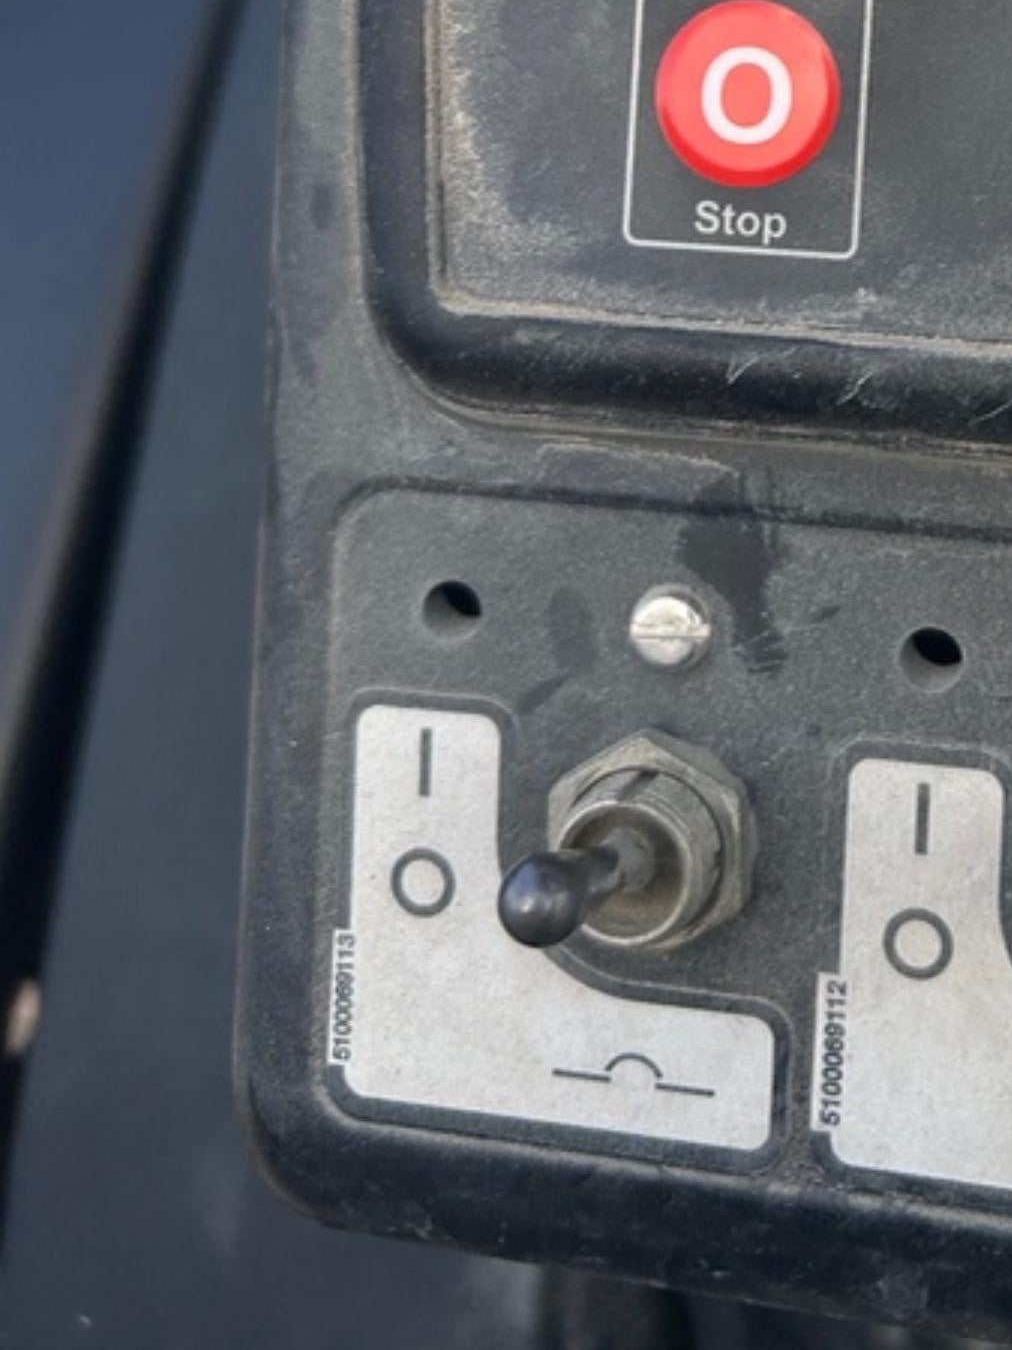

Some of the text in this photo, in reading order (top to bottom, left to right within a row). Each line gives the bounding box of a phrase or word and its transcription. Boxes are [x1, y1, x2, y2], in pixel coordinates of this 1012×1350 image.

[694, 199, 788, 246] Stop
[333, 933, 356, 1060] 5100069113
[819, 981, 847, 1125] 5100069112
